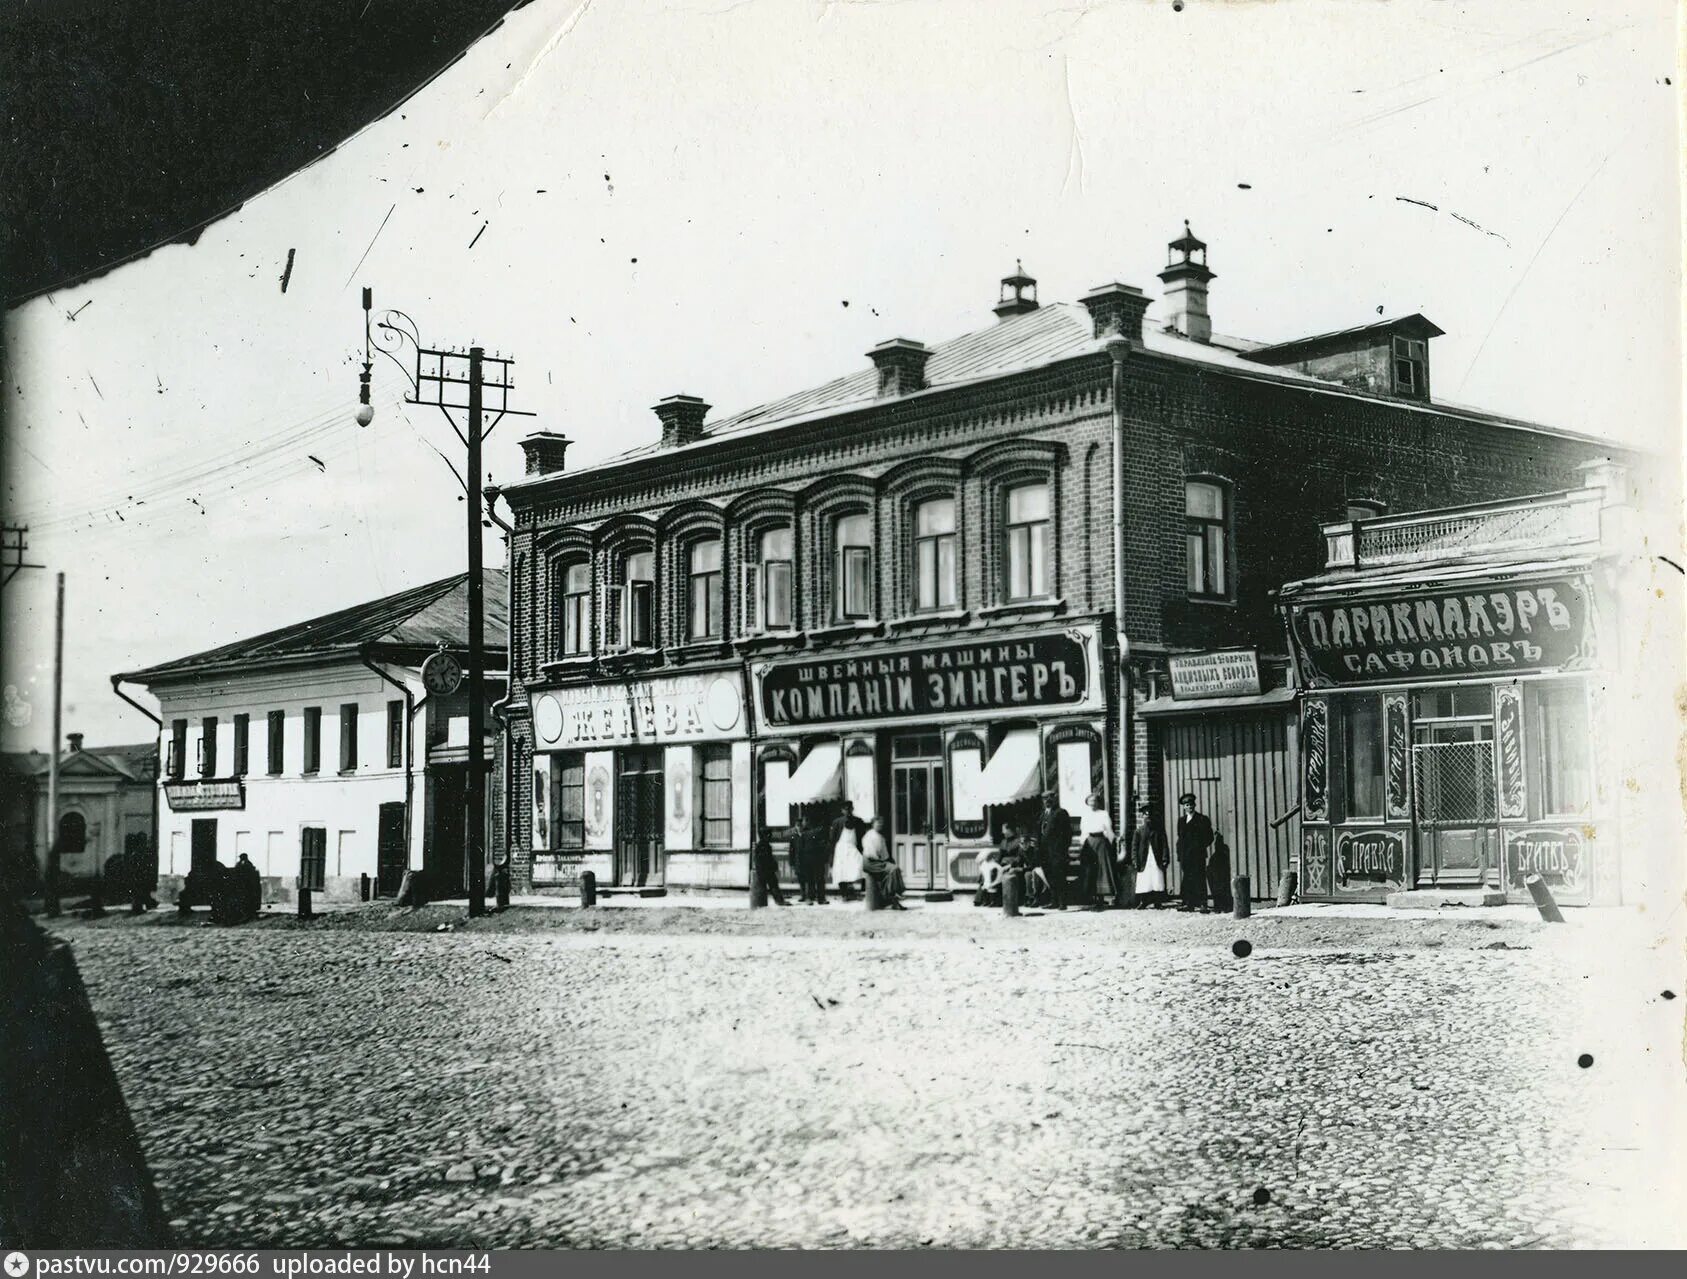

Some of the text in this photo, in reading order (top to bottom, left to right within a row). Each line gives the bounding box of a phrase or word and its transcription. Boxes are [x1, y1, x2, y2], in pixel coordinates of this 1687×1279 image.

[1306, 587, 1571, 649] ПАРИКМАХЭРЪ
[798, 643, 1035, 682] ШВЕЙНЫЯ МАШИНЫ
[1343, 639, 1542, 674] САФОНОВЪ
[771, 661, 1076, 721] КОМПАНІИ ЗИНГЕРЪ
[1307, 717, 1325, 794] СТРИЖКА
[1501, 711, 1521, 794] ЗАВИВКА
[1352, 840, 1394, 874] ПРАВКА
[1517, 841, 1569, 872] БРИТВЪ
